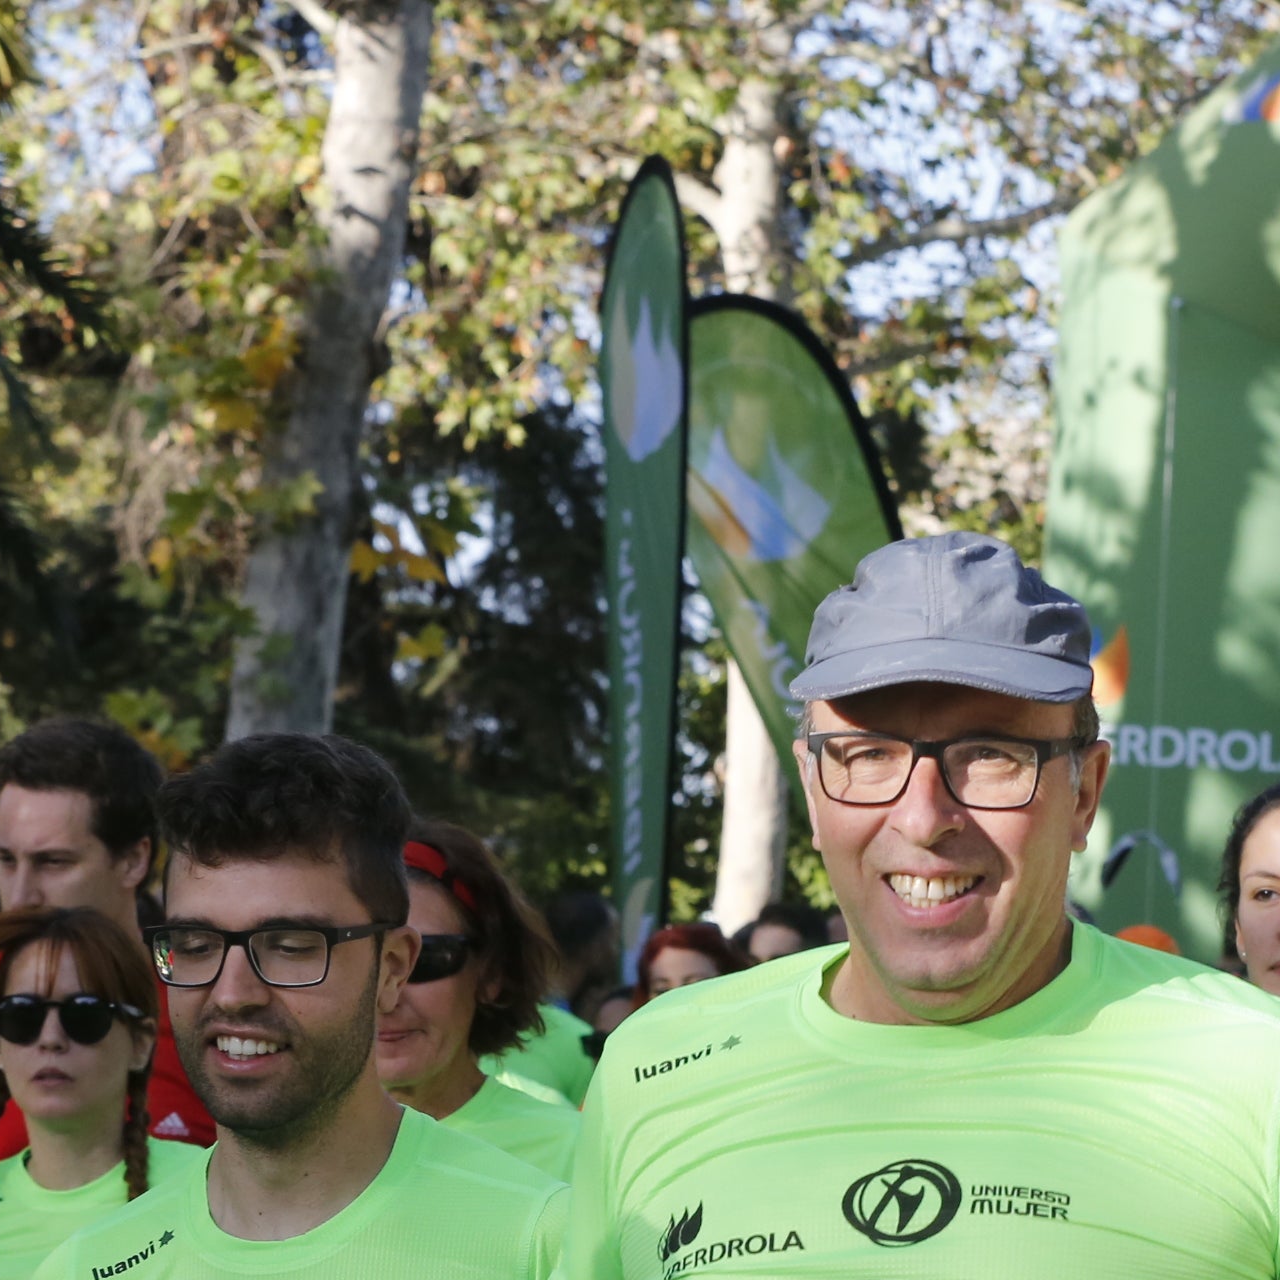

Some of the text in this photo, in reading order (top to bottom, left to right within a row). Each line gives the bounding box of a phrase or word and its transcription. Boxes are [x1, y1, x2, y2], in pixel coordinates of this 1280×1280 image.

[634, 1044, 713, 1083] luanvi
[971, 1184, 1071, 1206] UNIVERSO
[970, 1199, 1069, 1221] MUJER
